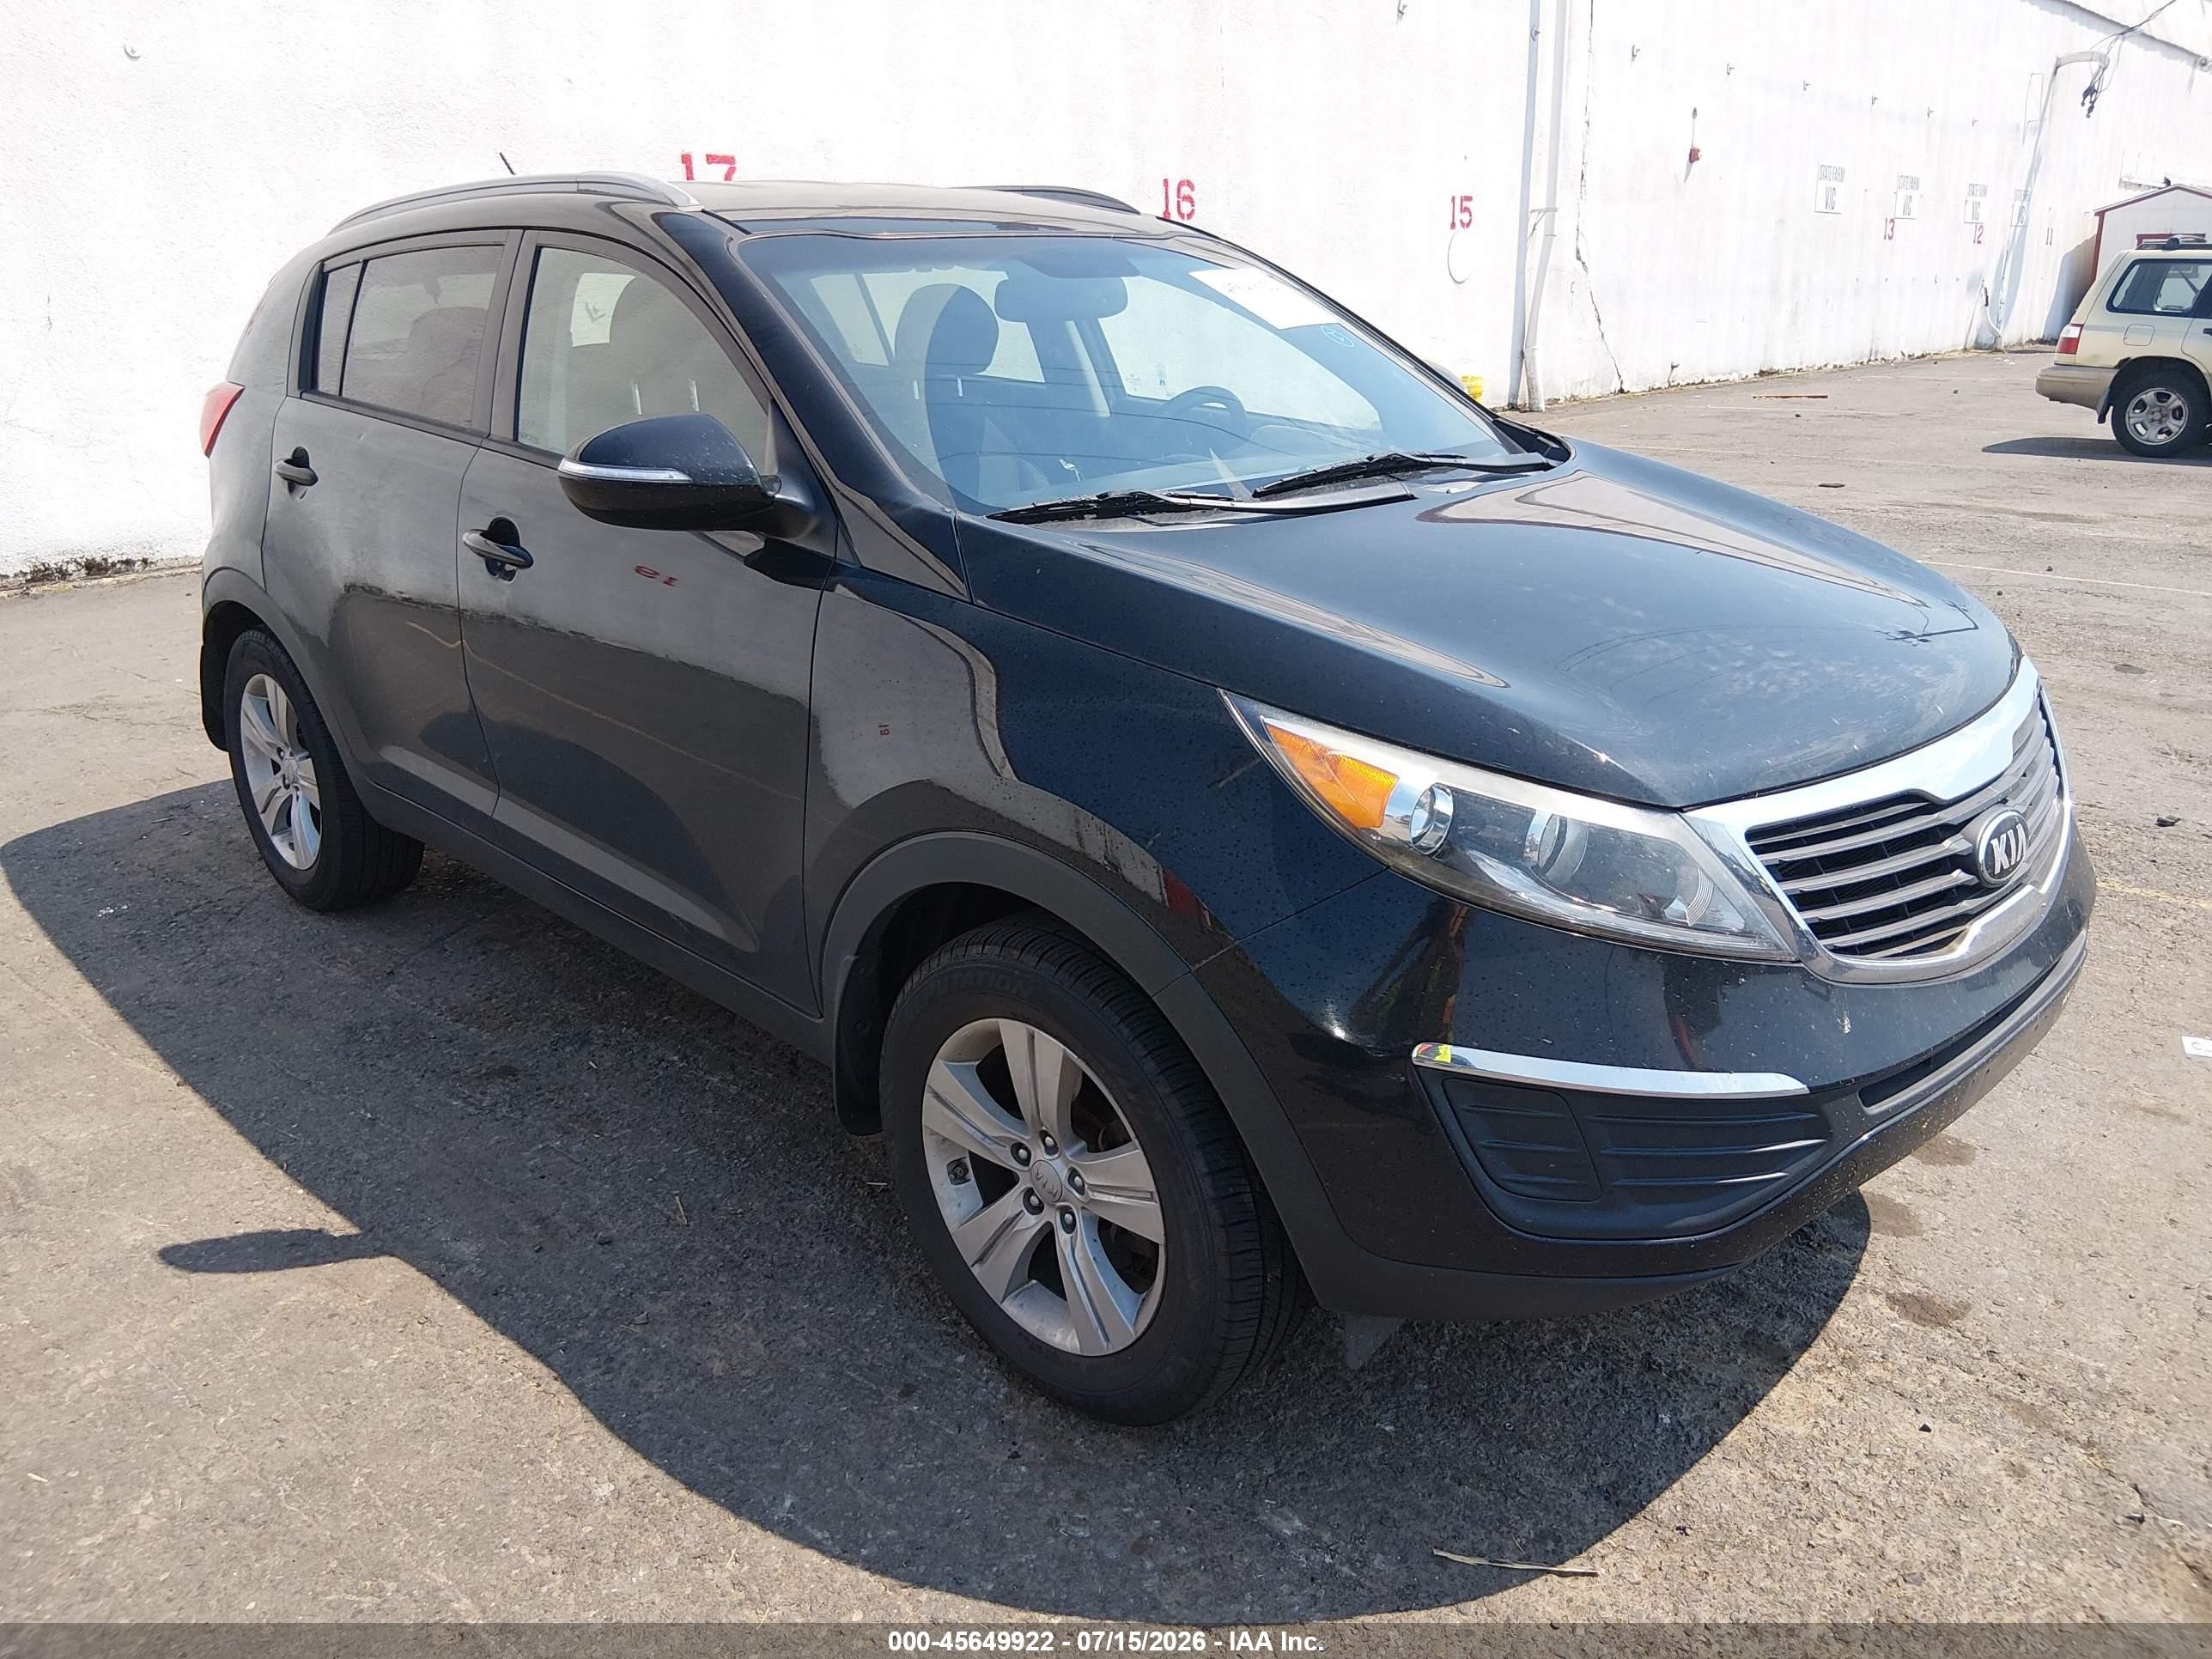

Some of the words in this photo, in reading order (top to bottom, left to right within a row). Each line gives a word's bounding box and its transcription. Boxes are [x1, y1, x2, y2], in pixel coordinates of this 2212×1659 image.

[681, 154, 737, 181] 17
[1819, 164, 1832, 181] STATE
[1163, 179, 1195, 220] 16
[1825, 186, 1837, 210] VIC
[1450, 196, 1473, 229] 15
[1883, 218, 1895, 241] 13
[1972, 224, 1984, 245] 12
[2045, 227, 2054, 246] 11
[1990, 823, 2027, 874] KIA
